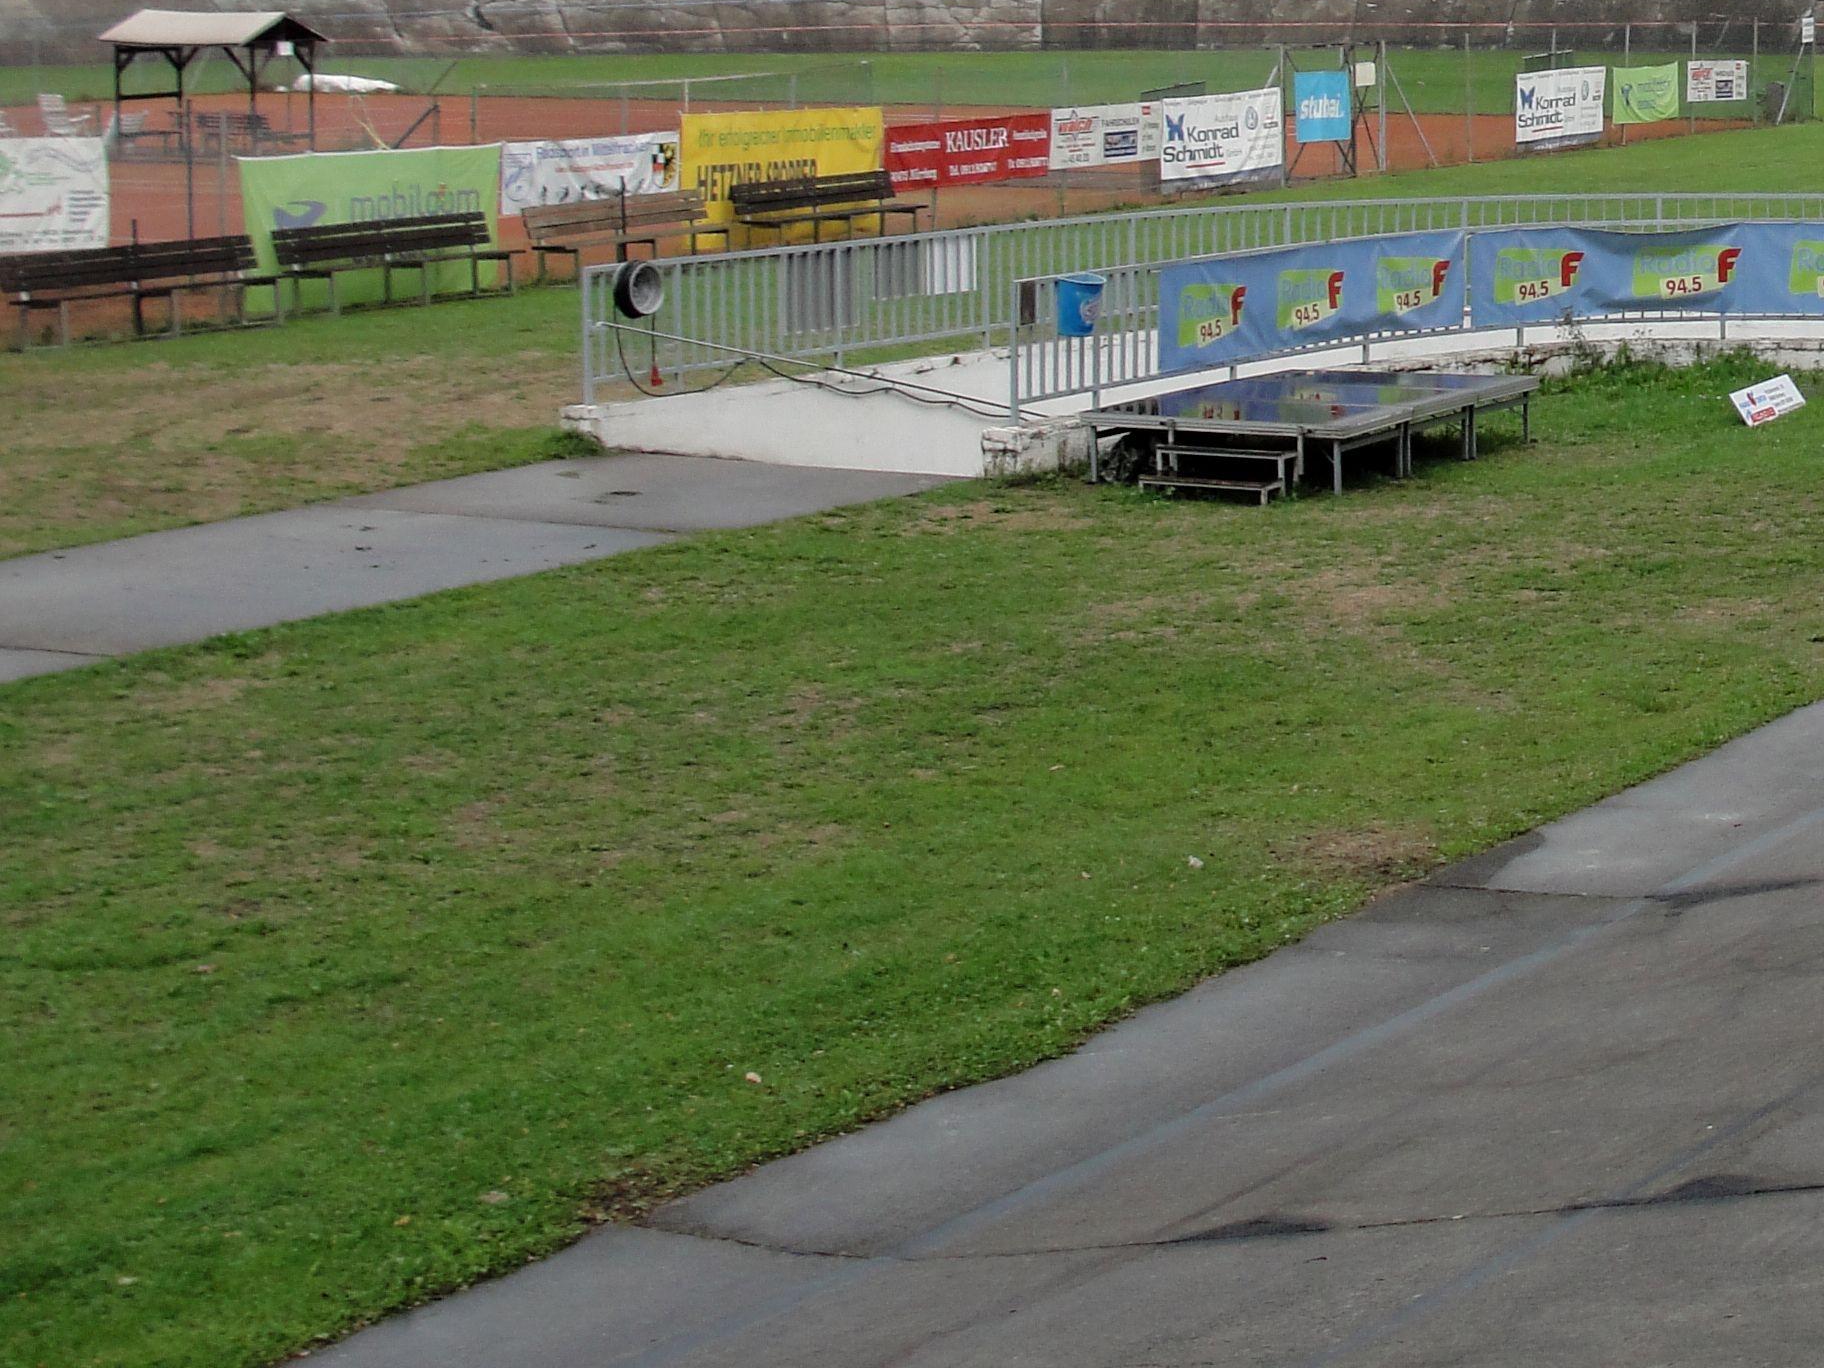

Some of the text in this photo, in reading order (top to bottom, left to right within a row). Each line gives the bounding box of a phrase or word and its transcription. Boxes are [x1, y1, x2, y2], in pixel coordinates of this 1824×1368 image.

[1300, 93, 1343, 120] stubai
[1536, 93, 1577, 111] Konrad
[1518, 110, 1563, 128] Schmidt
[946, 126, 1009, 153] KAUSLER
[1186, 122, 1240, 143] Konrad
[1163, 141, 1225, 163] Schmidt
[351, 183, 481, 221] mobilcom
[1561, 252, 1585, 287] F
[1718, 248, 1742, 283] F
[1328, 271, 1345, 309] F
[1432, 260, 1450, 296] F
[1665, 276, 1702, 295] 94.5
[1396, 290, 1421, 309] 94.5
[1519, 281, 1549, 300] 94.5
[1231, 285, 1247, 325] F
[1295, 303, 1320, 325] 94.5
[1200, 318, 1222, 342] 94.5
